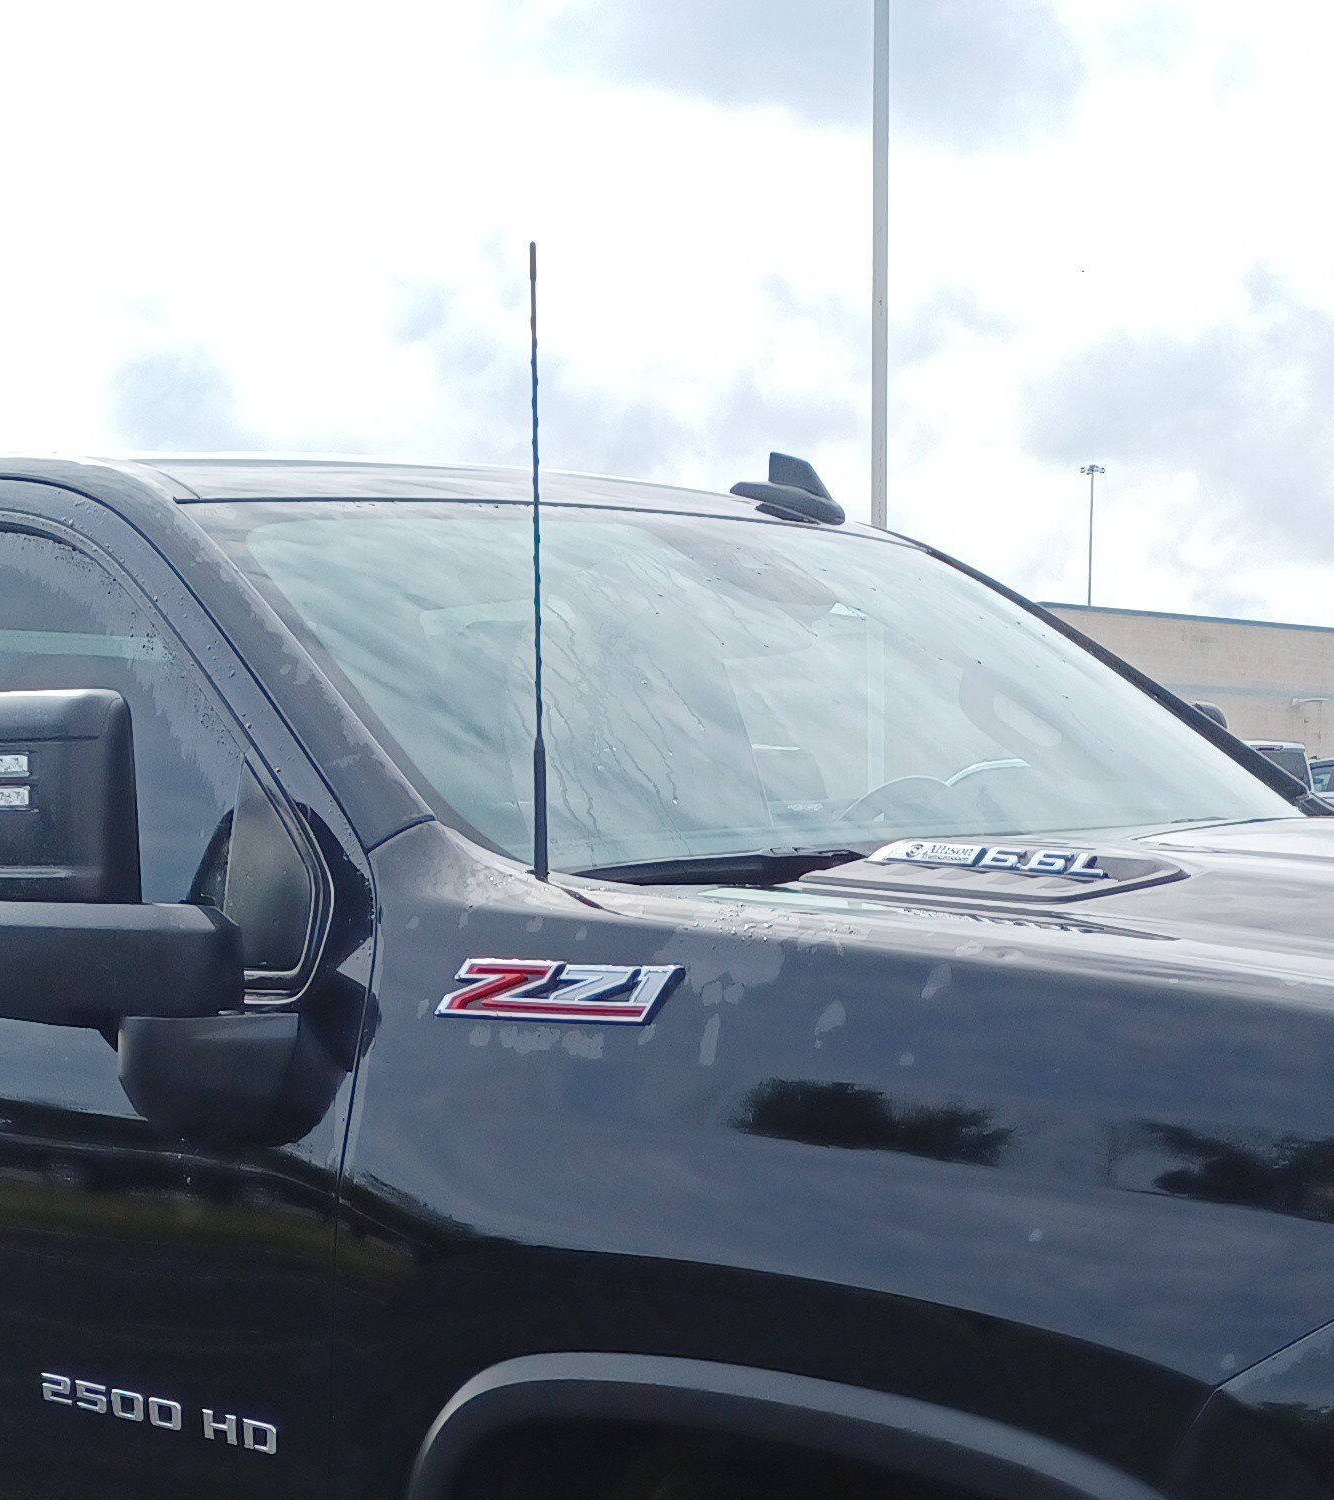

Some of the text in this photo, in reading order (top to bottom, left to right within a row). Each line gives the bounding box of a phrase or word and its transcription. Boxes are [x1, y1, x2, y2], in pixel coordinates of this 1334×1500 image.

[978, 846, 1104, 877] 6.6L
[434, 957, 685, 1025] Z71
[40, 1371, 277, 1455] 2500 HD
